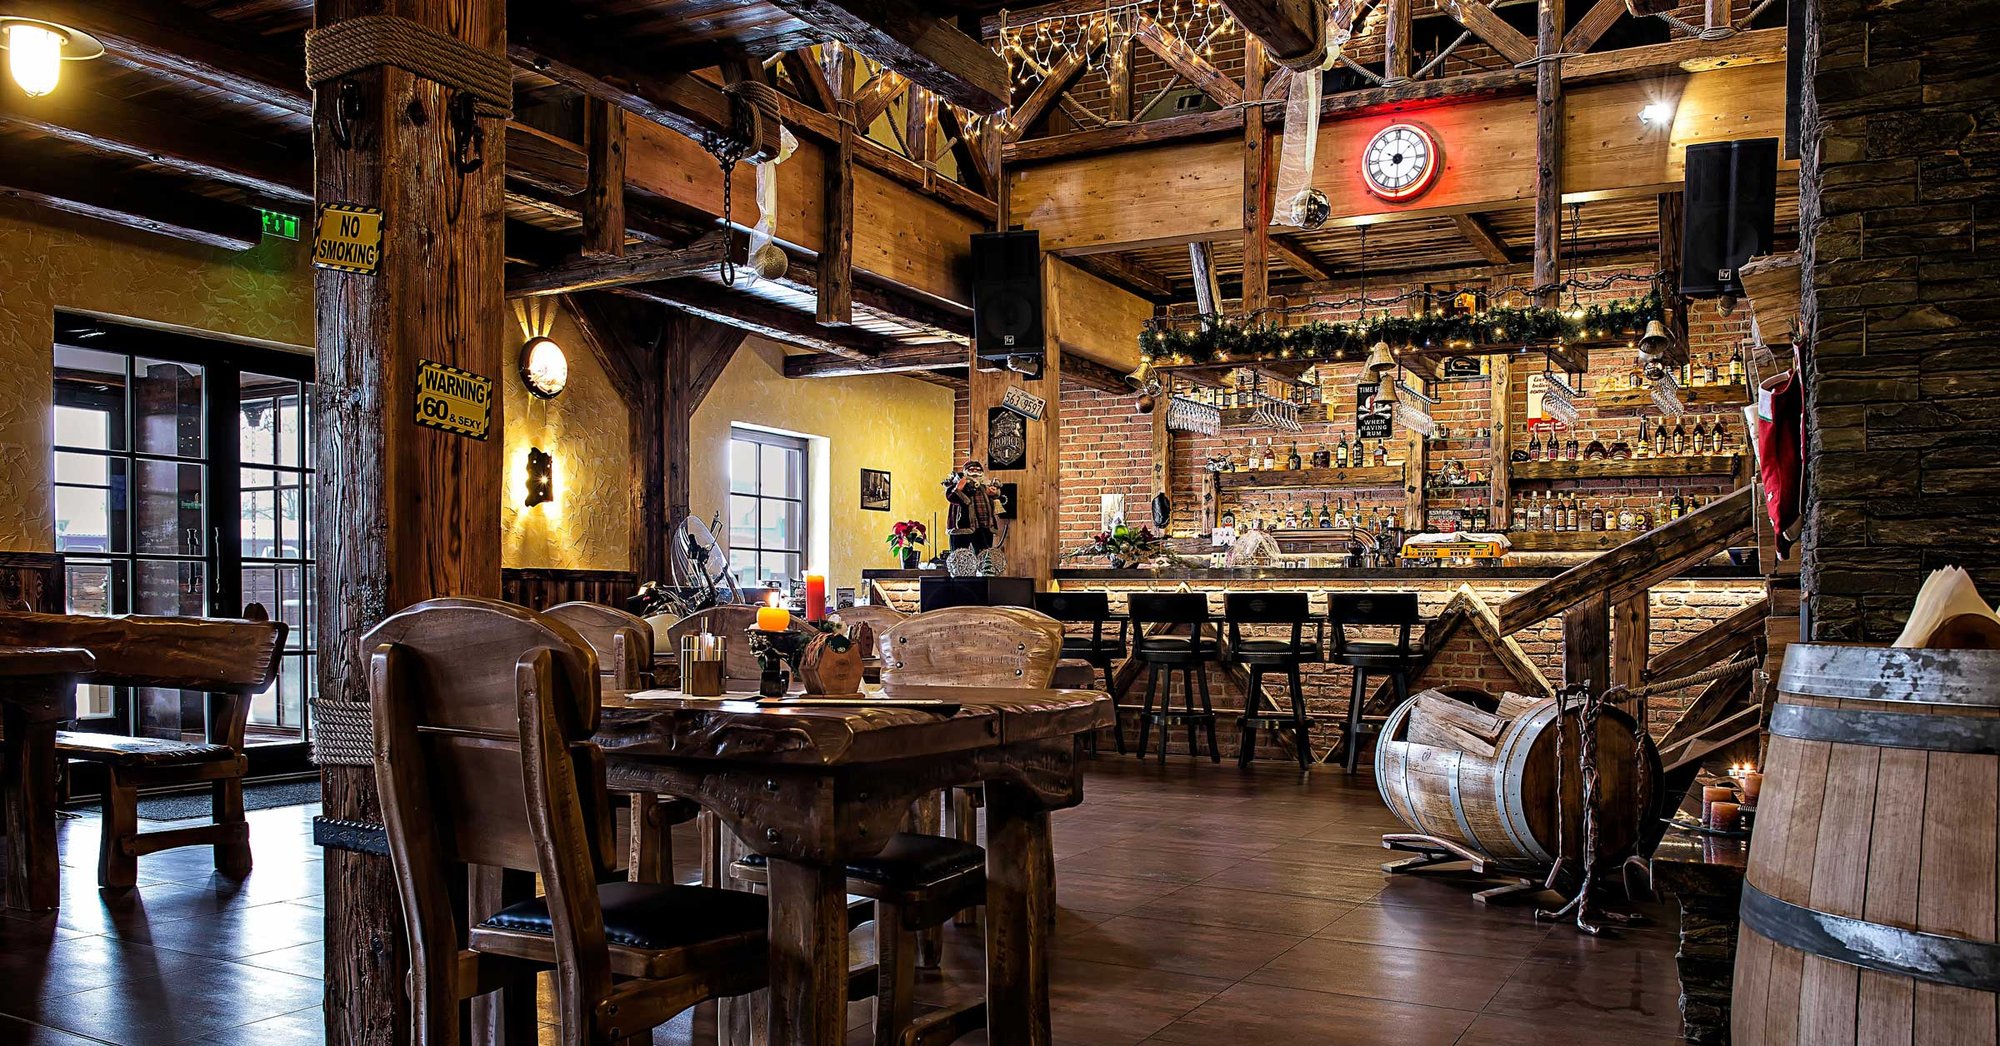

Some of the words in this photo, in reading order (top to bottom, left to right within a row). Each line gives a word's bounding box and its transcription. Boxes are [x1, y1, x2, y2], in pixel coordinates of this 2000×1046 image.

[339, 214, 361, 239] NO
[318, 239, 375, 266] SMOKING
[424, 367, 486, 404] WARNING
[422, 396, 449, 421] 60
[449, 413, 457, 423] &
[458, 415, 482, 430] SEXY
[1005, 391, 1021, 406] 563
[1022, 399, 1042, 416] 9597
[994, 436, 1020, 448] POLICE
